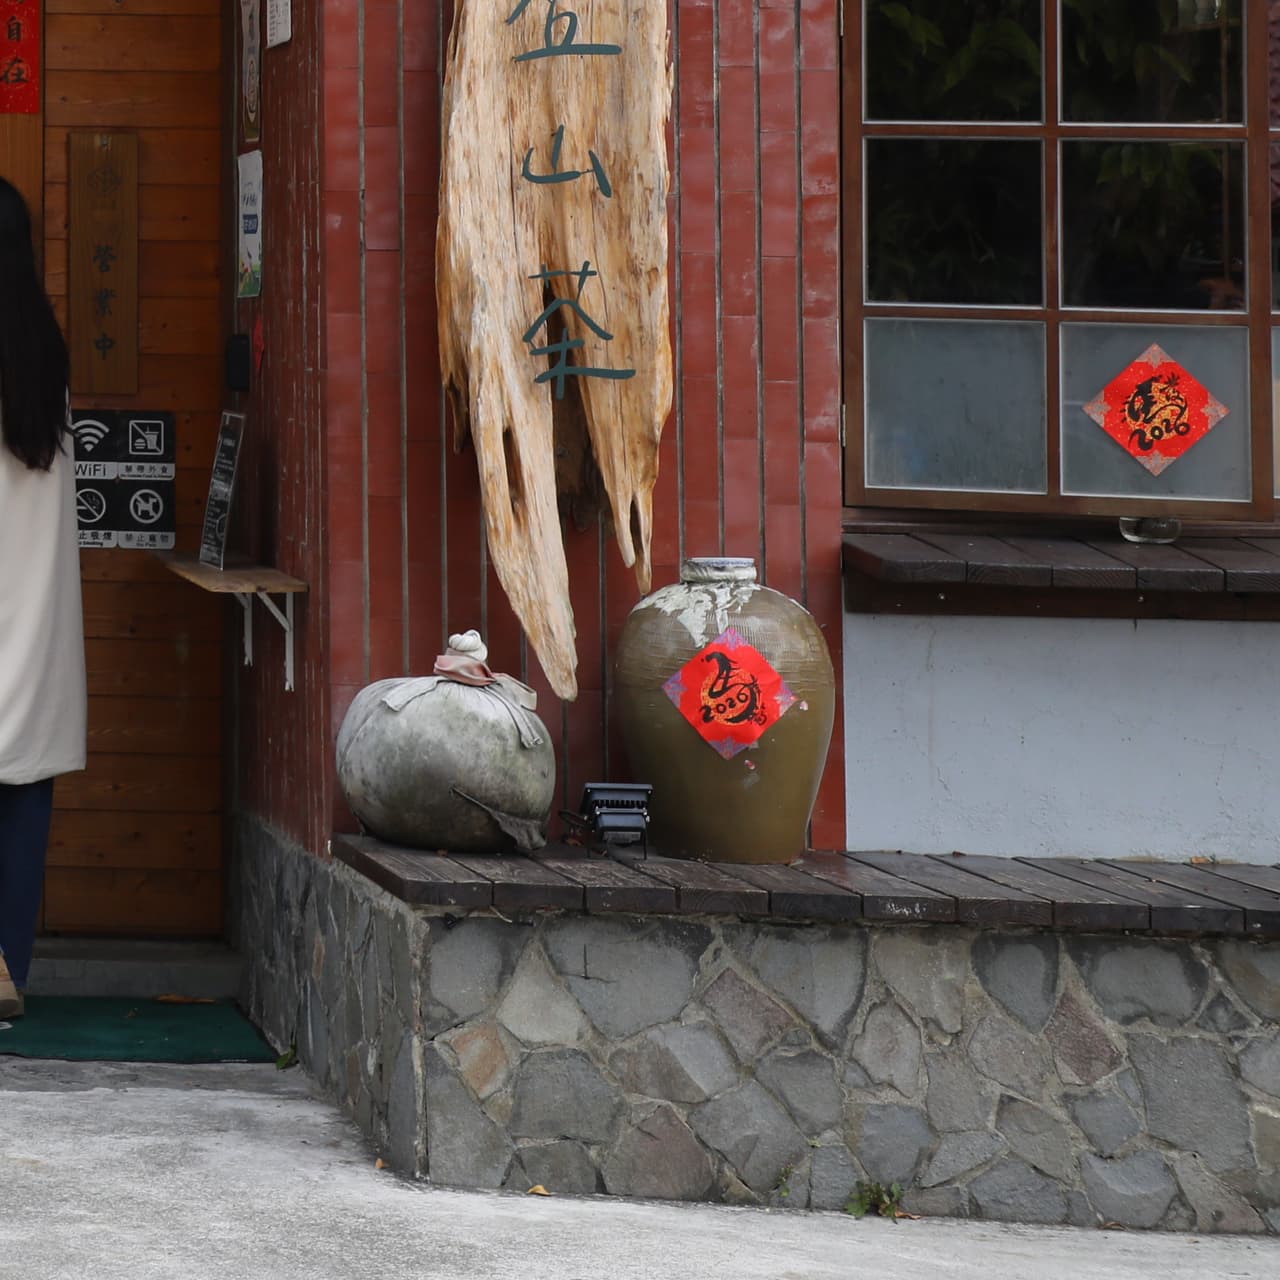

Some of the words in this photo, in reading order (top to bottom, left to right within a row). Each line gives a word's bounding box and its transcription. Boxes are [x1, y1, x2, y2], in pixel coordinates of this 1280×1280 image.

[92, 243, 118, 362] 營業中
[75, 464, 106, 476] WiFi
[79, 531, 113, 541] 止吸煙
[698, 689, 749, 724] 2026
